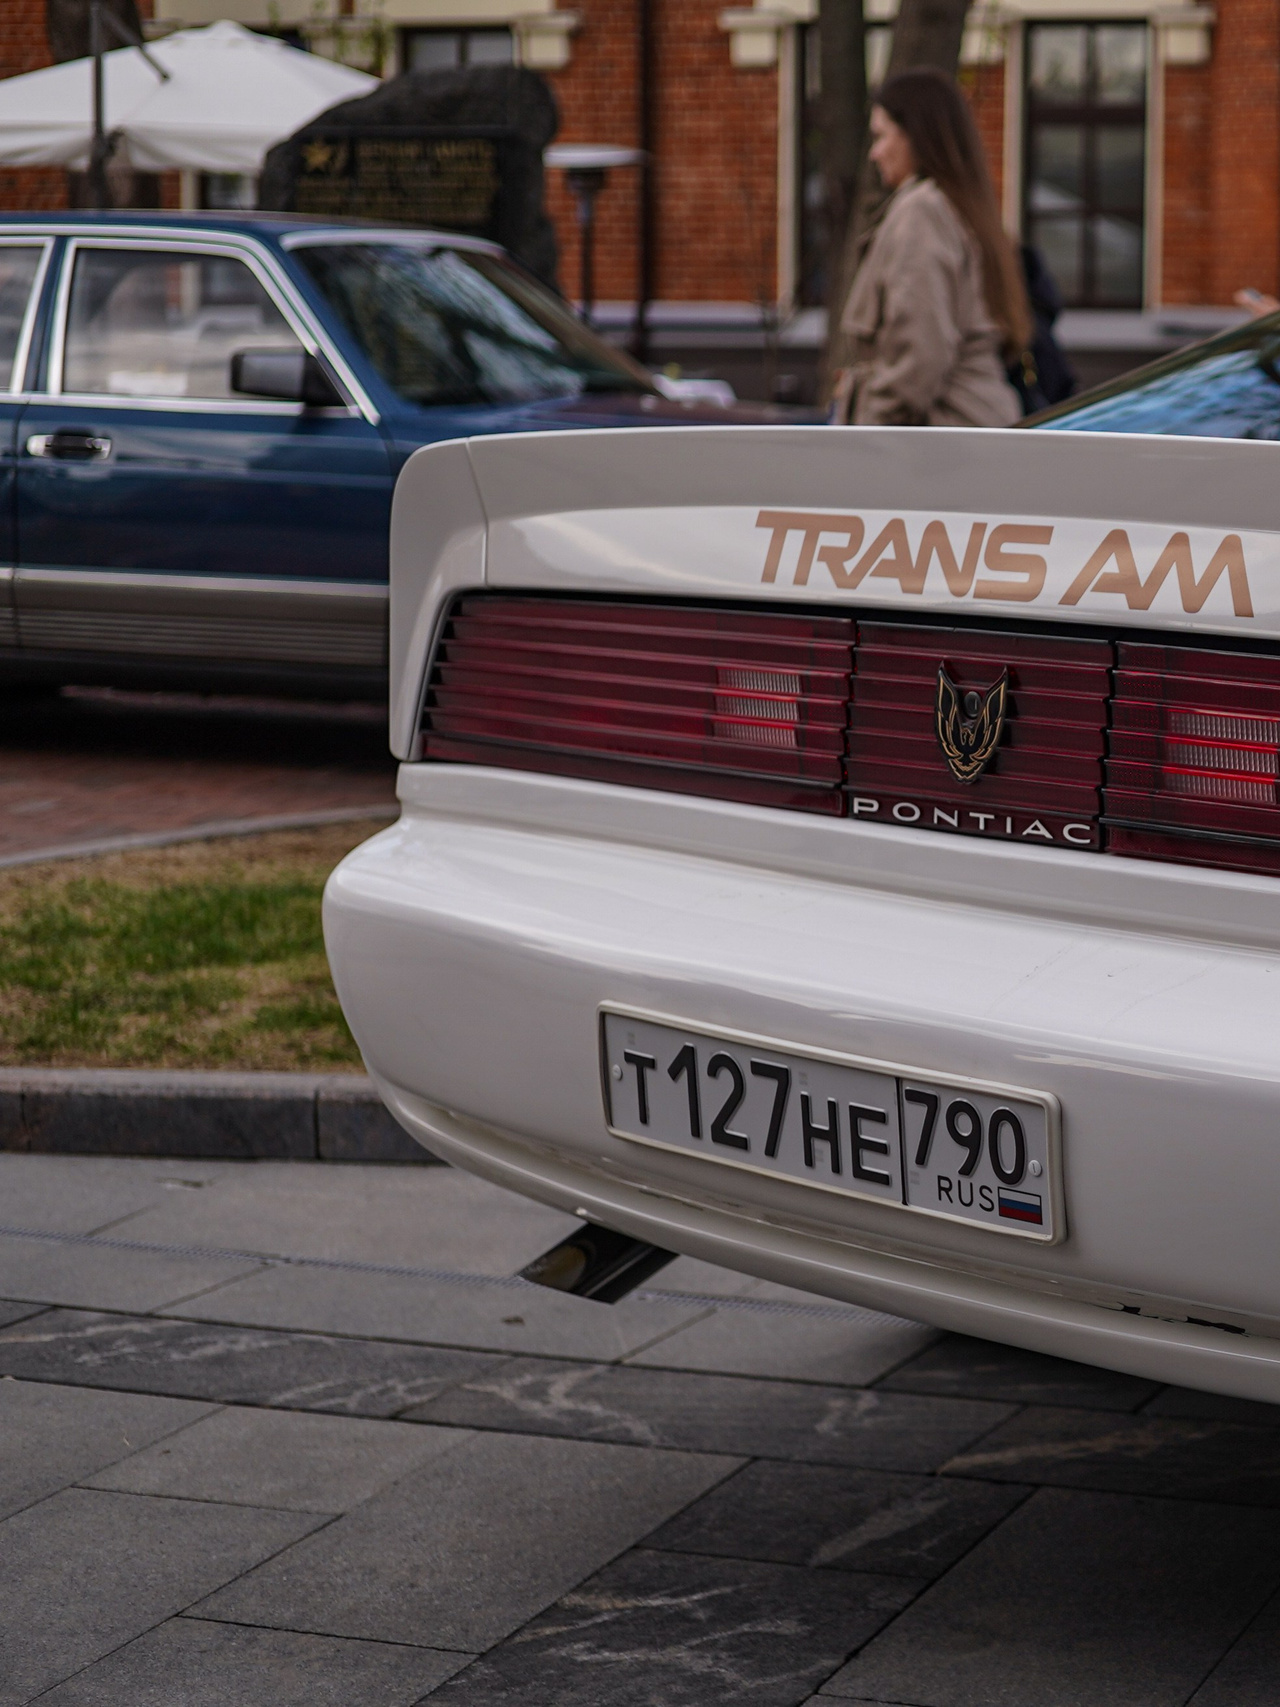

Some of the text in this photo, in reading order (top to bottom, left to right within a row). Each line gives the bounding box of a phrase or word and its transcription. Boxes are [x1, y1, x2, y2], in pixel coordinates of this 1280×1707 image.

[755, 510, 1255, 618] TRANS AM
[853, 797, 1092, 845] PONTIAC
[904, 1087, 1026, 1186] 790
[937, 1175, 996, 1213] RUS
